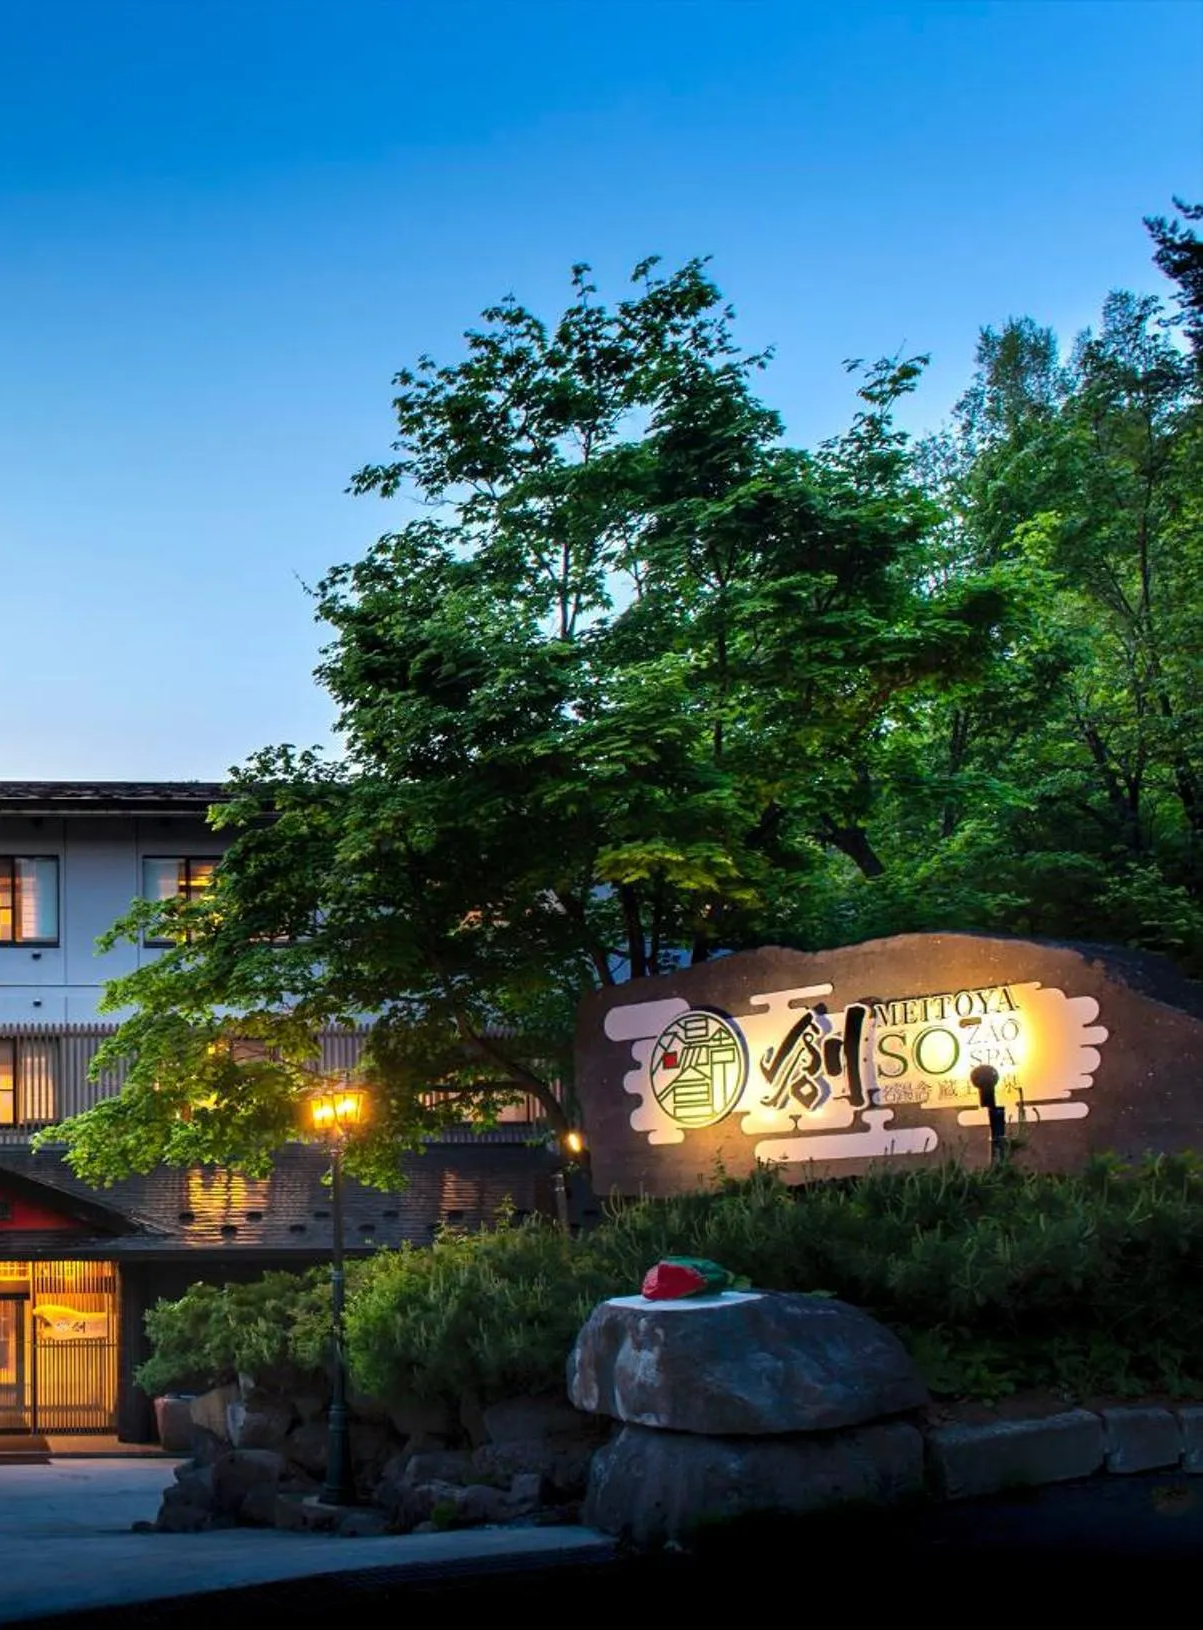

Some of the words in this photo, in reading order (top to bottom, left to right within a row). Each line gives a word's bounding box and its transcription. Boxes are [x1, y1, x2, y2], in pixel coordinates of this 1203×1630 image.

[875, 985, 1020, 1028] MEITOYA
[967, 1018, 1020, 1045] ZAO
[877, 1027, 960, 1078] SO
[969, 1048, 1017, 1068] SPA
